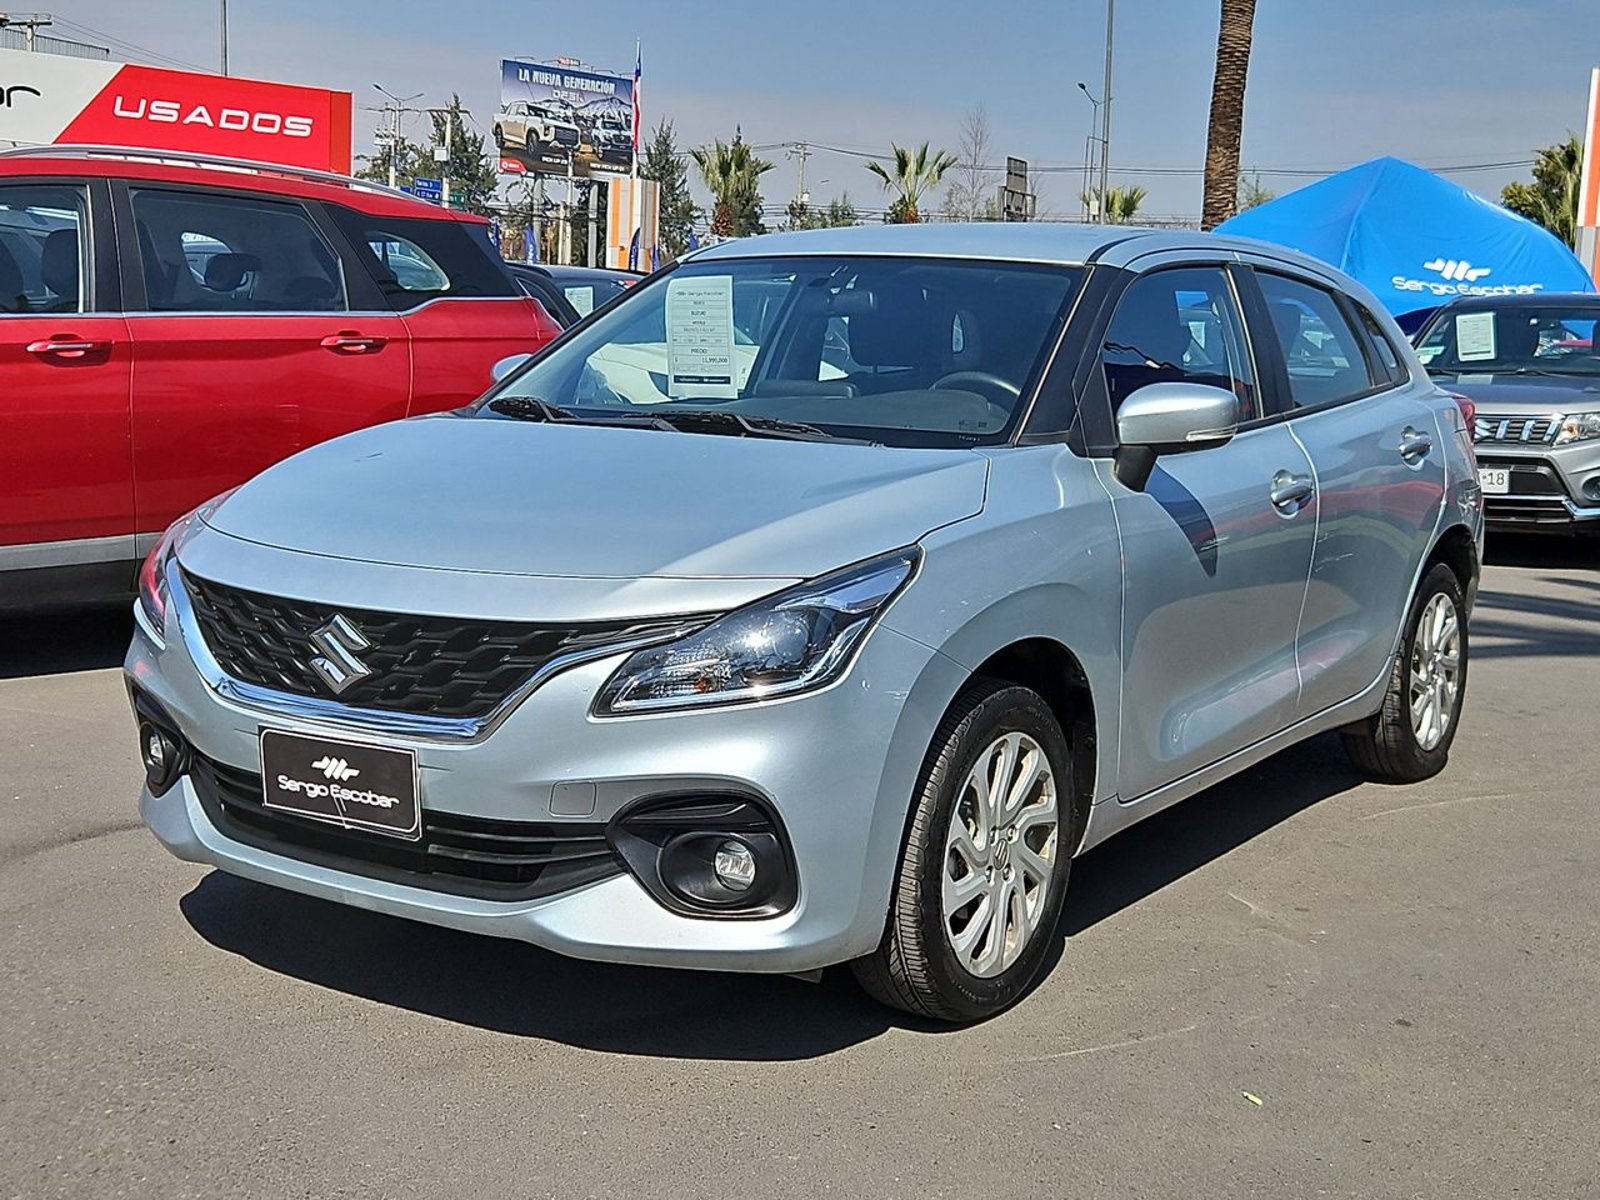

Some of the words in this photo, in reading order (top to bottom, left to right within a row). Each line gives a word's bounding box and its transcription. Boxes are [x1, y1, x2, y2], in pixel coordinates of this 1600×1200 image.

[518, 68, 530, 82] LA
[532, 70, 562, 87] NUEVA
[564, 75, 616, 95] GENERACIÓN
[113, 95, 313, 137] USADOS
[1392, 276, 1457, 296] Sergo
[1487, 471, 1505, 486] 18
[277, 774, 329, 798] Sergo
[329, 783, 400, 809] Escobar
